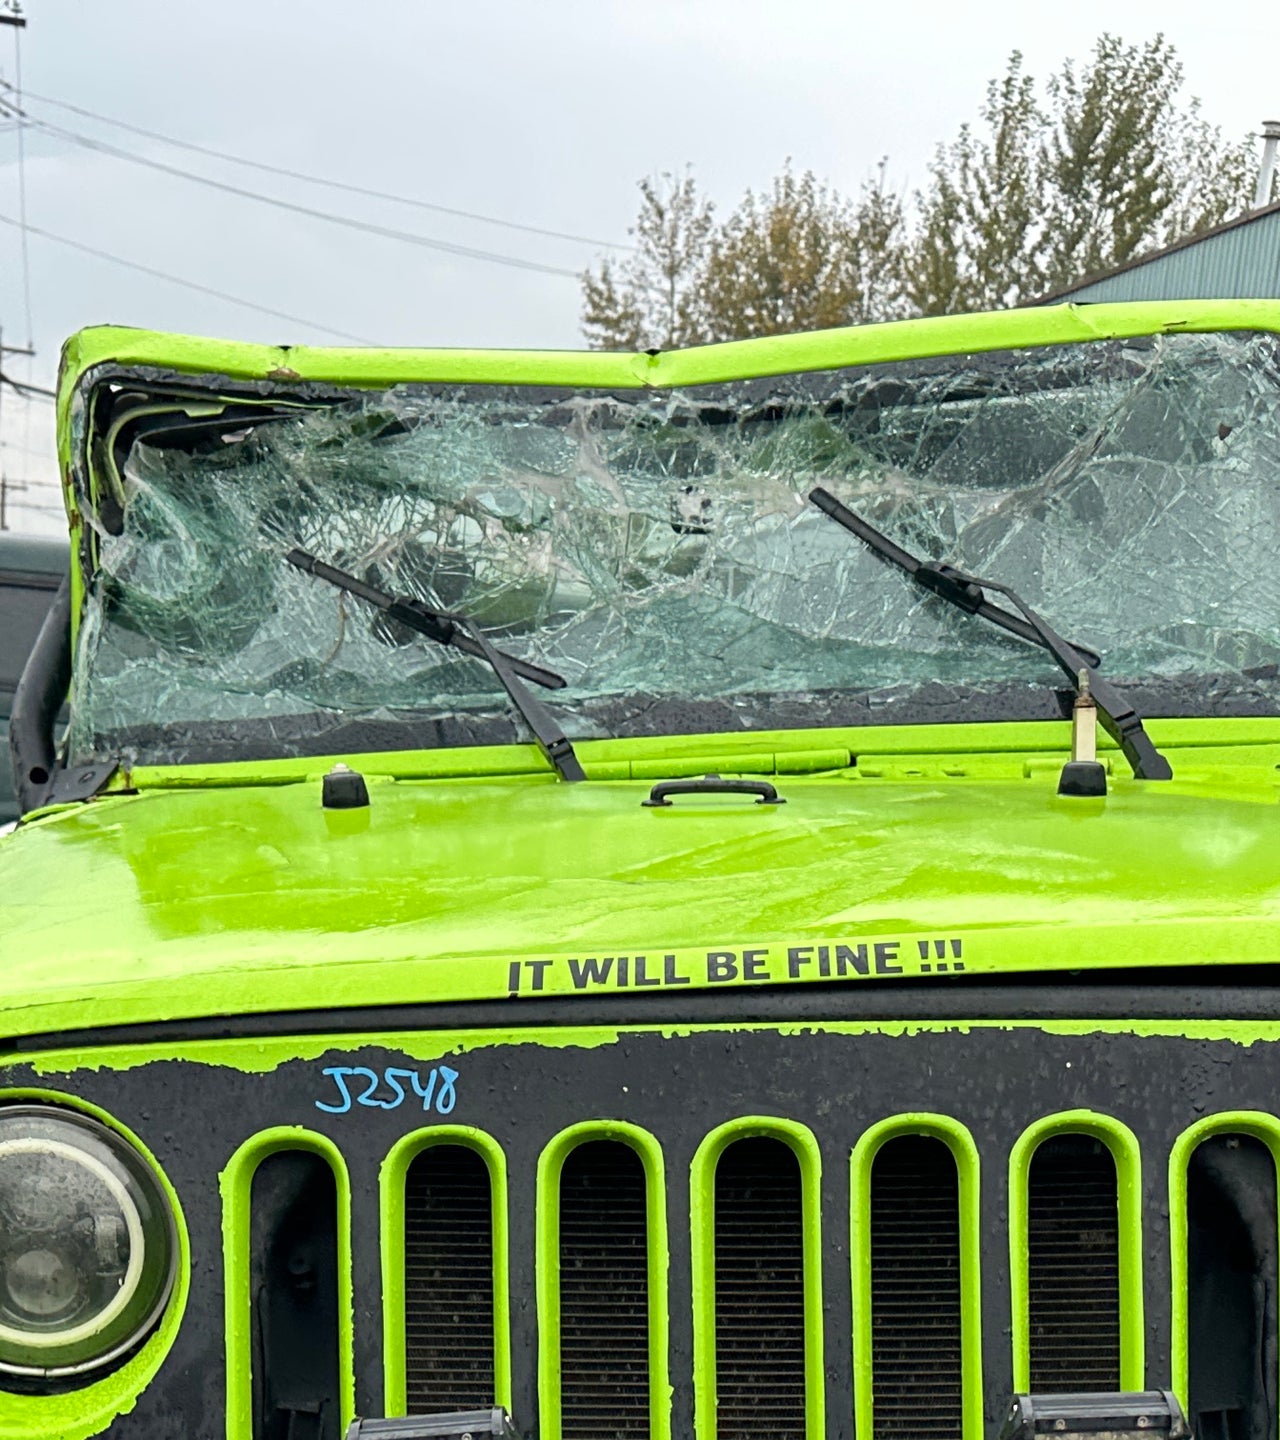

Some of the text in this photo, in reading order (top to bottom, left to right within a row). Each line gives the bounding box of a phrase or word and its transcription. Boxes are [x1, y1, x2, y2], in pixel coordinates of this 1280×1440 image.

[507, 938, 966, 993] IT WILL BE FINE !!!
[314, 1065, 460, 1115] J2548
